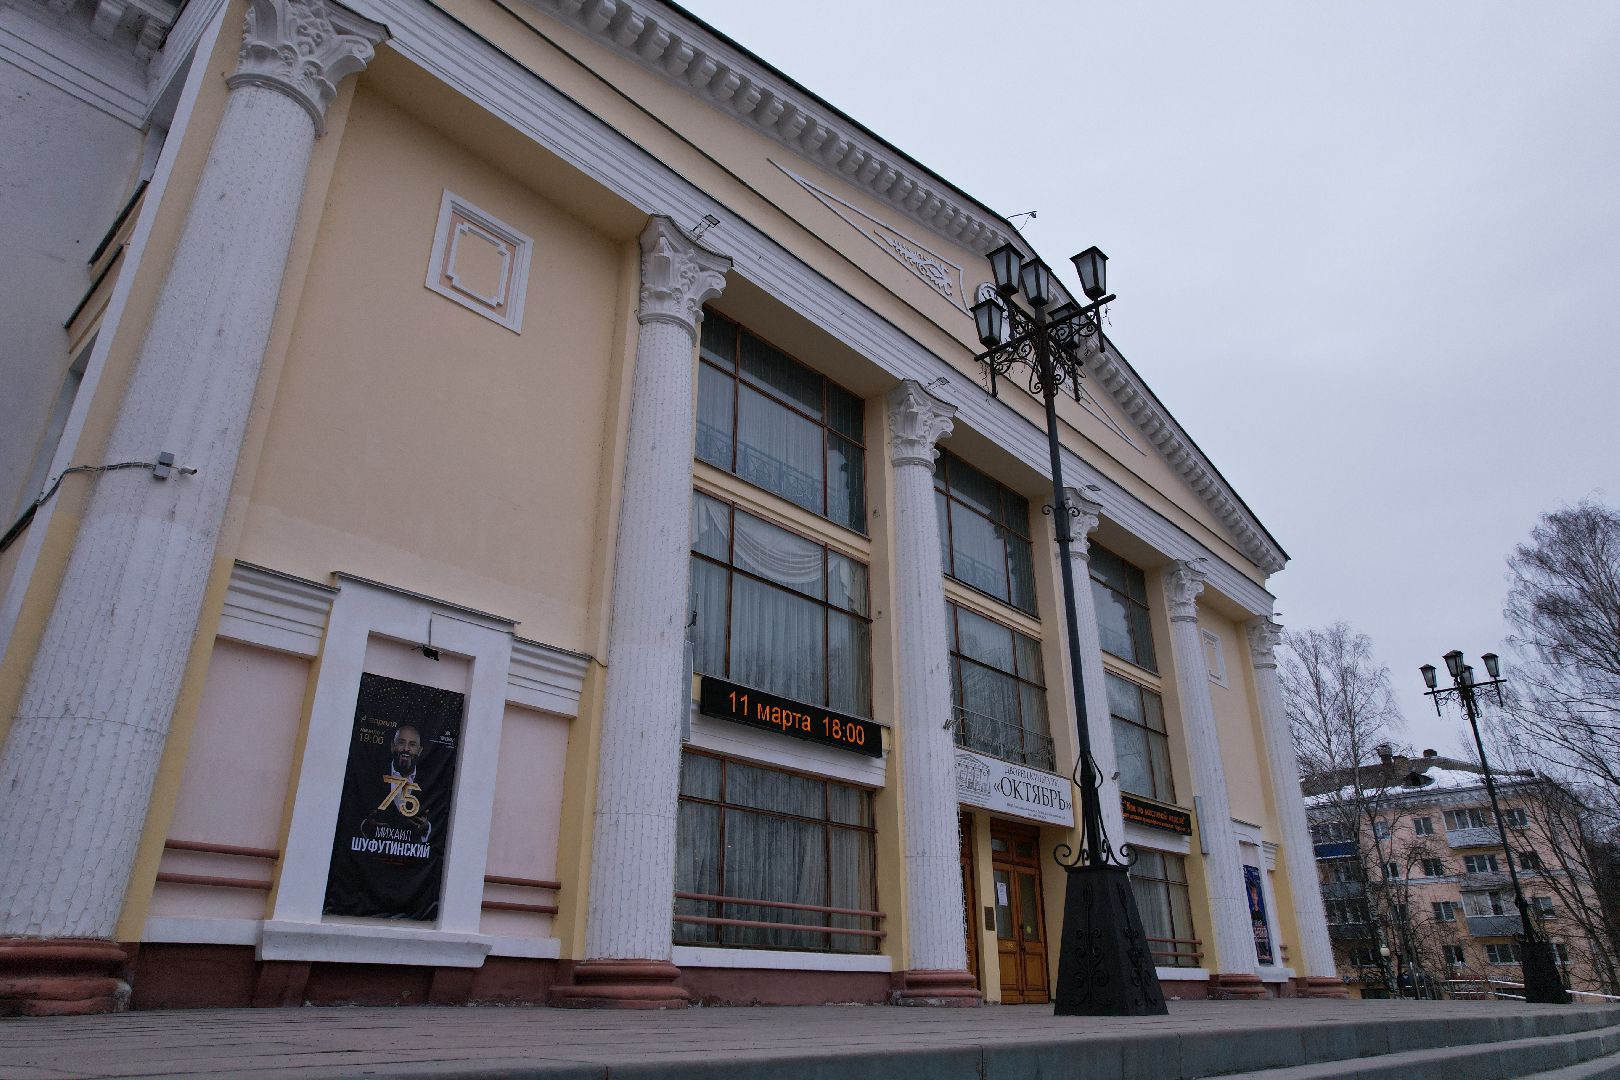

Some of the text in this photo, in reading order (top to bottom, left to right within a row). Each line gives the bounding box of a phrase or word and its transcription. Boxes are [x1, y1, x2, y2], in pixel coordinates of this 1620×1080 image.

[729, 691, 865, 746] 11 марта 18:00
[360, 733, 384, 745] 19:00
[377, 774, 422, 817] 75
[994, 776, 1072, 811] «ОКТЯБРЬ»
[351, 836, 431, 859] ШУФУТИНСКИЙ
[375, 826, 412, 841] МИХАИЛ
